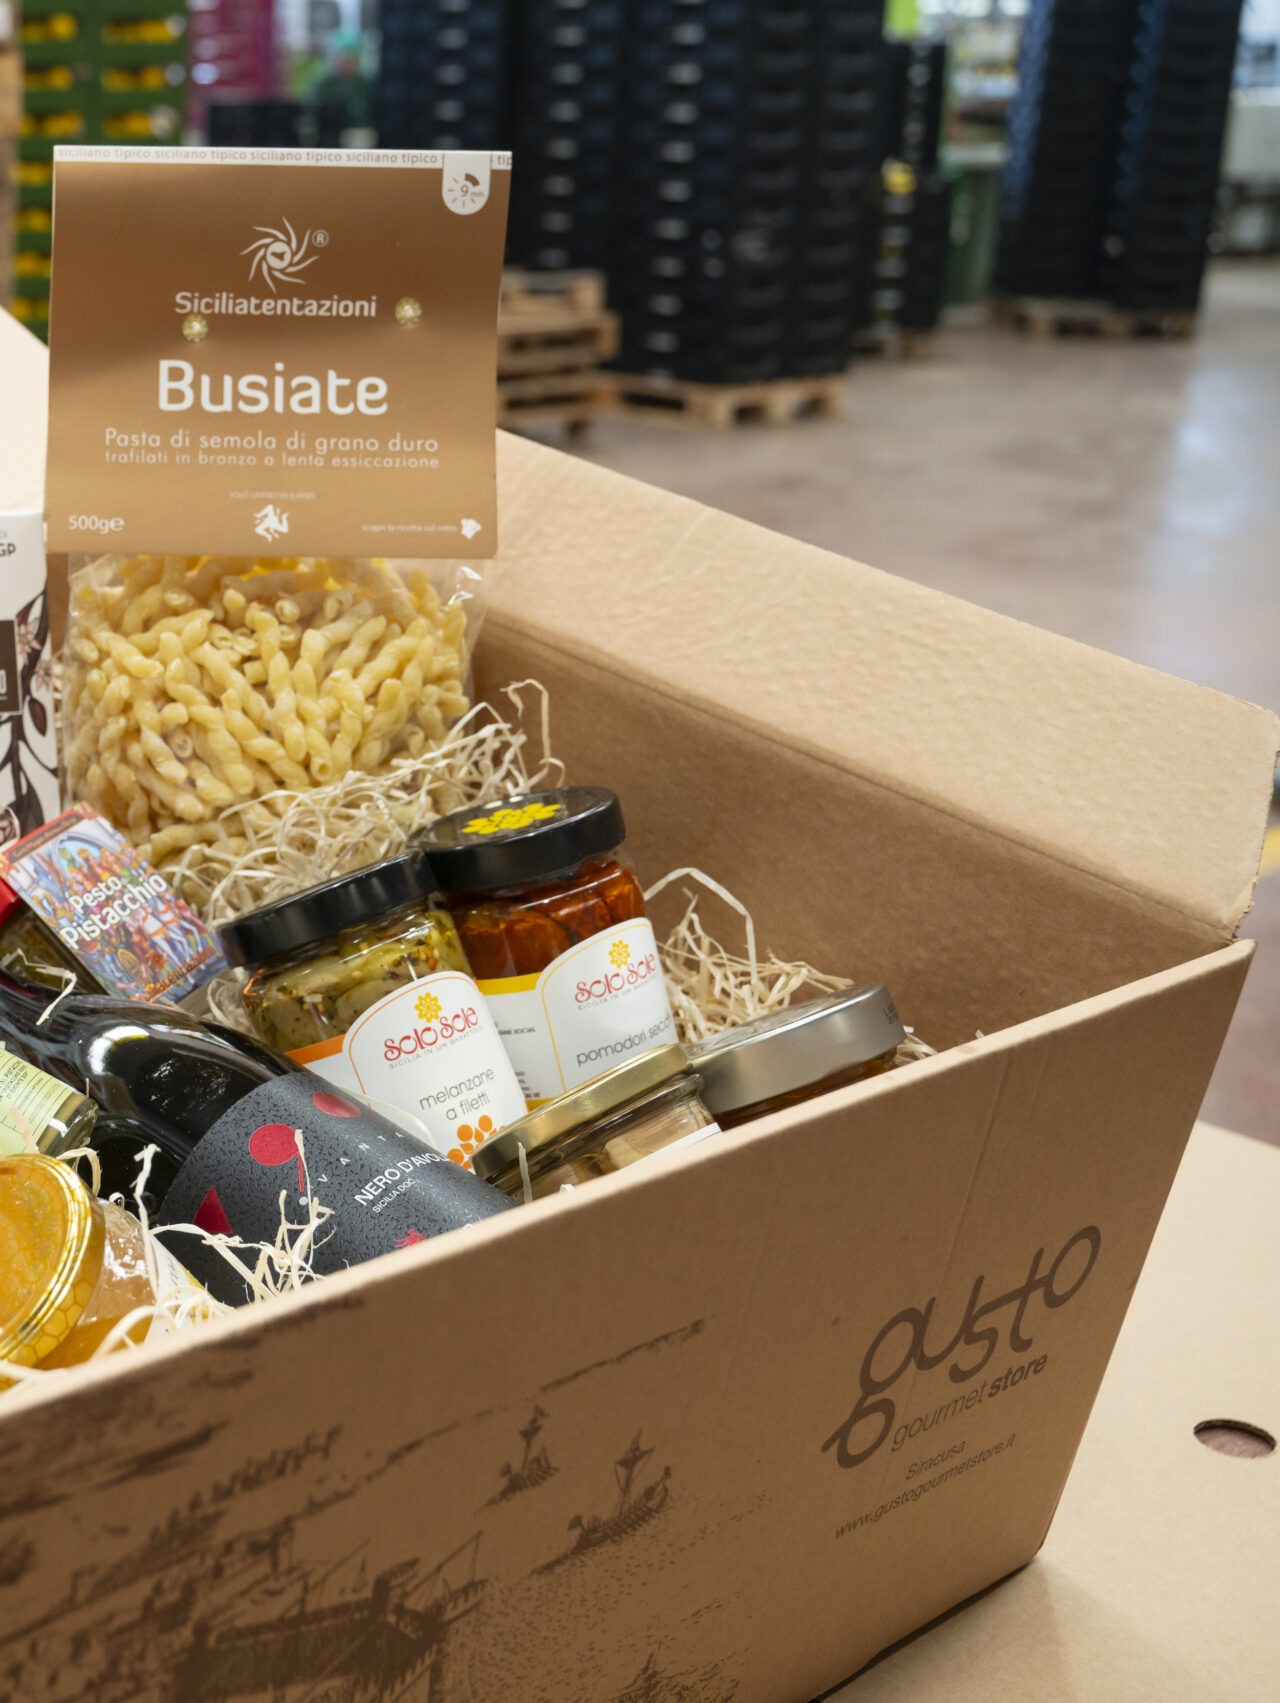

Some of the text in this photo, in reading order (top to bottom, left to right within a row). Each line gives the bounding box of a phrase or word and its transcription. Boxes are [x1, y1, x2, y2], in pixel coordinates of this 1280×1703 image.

[58, 149, 110, 159] siciliano
[115, 148, 151, 161] tipico
[155, 149, 207, 160] siciliano
[211, 149, 247, 162] tipico
[251, 150, 301, 161] siciliano
[306, 151, 342, 163] tipico
[346, 152, 398, 163] siciliano
[402, 152, 438, 165] tipico
[174, 291, 377, 318] Siciliatentazioni
[158, 359, 389, 416] Busiate
[105, 427, 439, 455] Pasta di semola di grano duro
[105, 449, 440, 469] trafilati in bronzo a lenta essiccazione
[59, 873, 168, 950] Pistacchio
[68, 874, 121, 915] Pesto
[389, 1053, 421, 1070] SICILIA
[424, 1048, 433, 1056] IN
[436, 1043, 447, 1052] UN
[576, 1028, 647, 1067] pomodori
[419, 1069, 494, 1110] melanzane
[446, 1090, 491, 1120] a filetti
[354, 1152, 450, 1206] NERO D'AVOL
[372, 1178, 416, 1214] SICILIA DOC
[821, 1225, 1101, 1469] gusto
[905, 1440, 966, 1481] Siracusa
[835, 1433, 1015, 1539] www.gustogourmetstore.it
